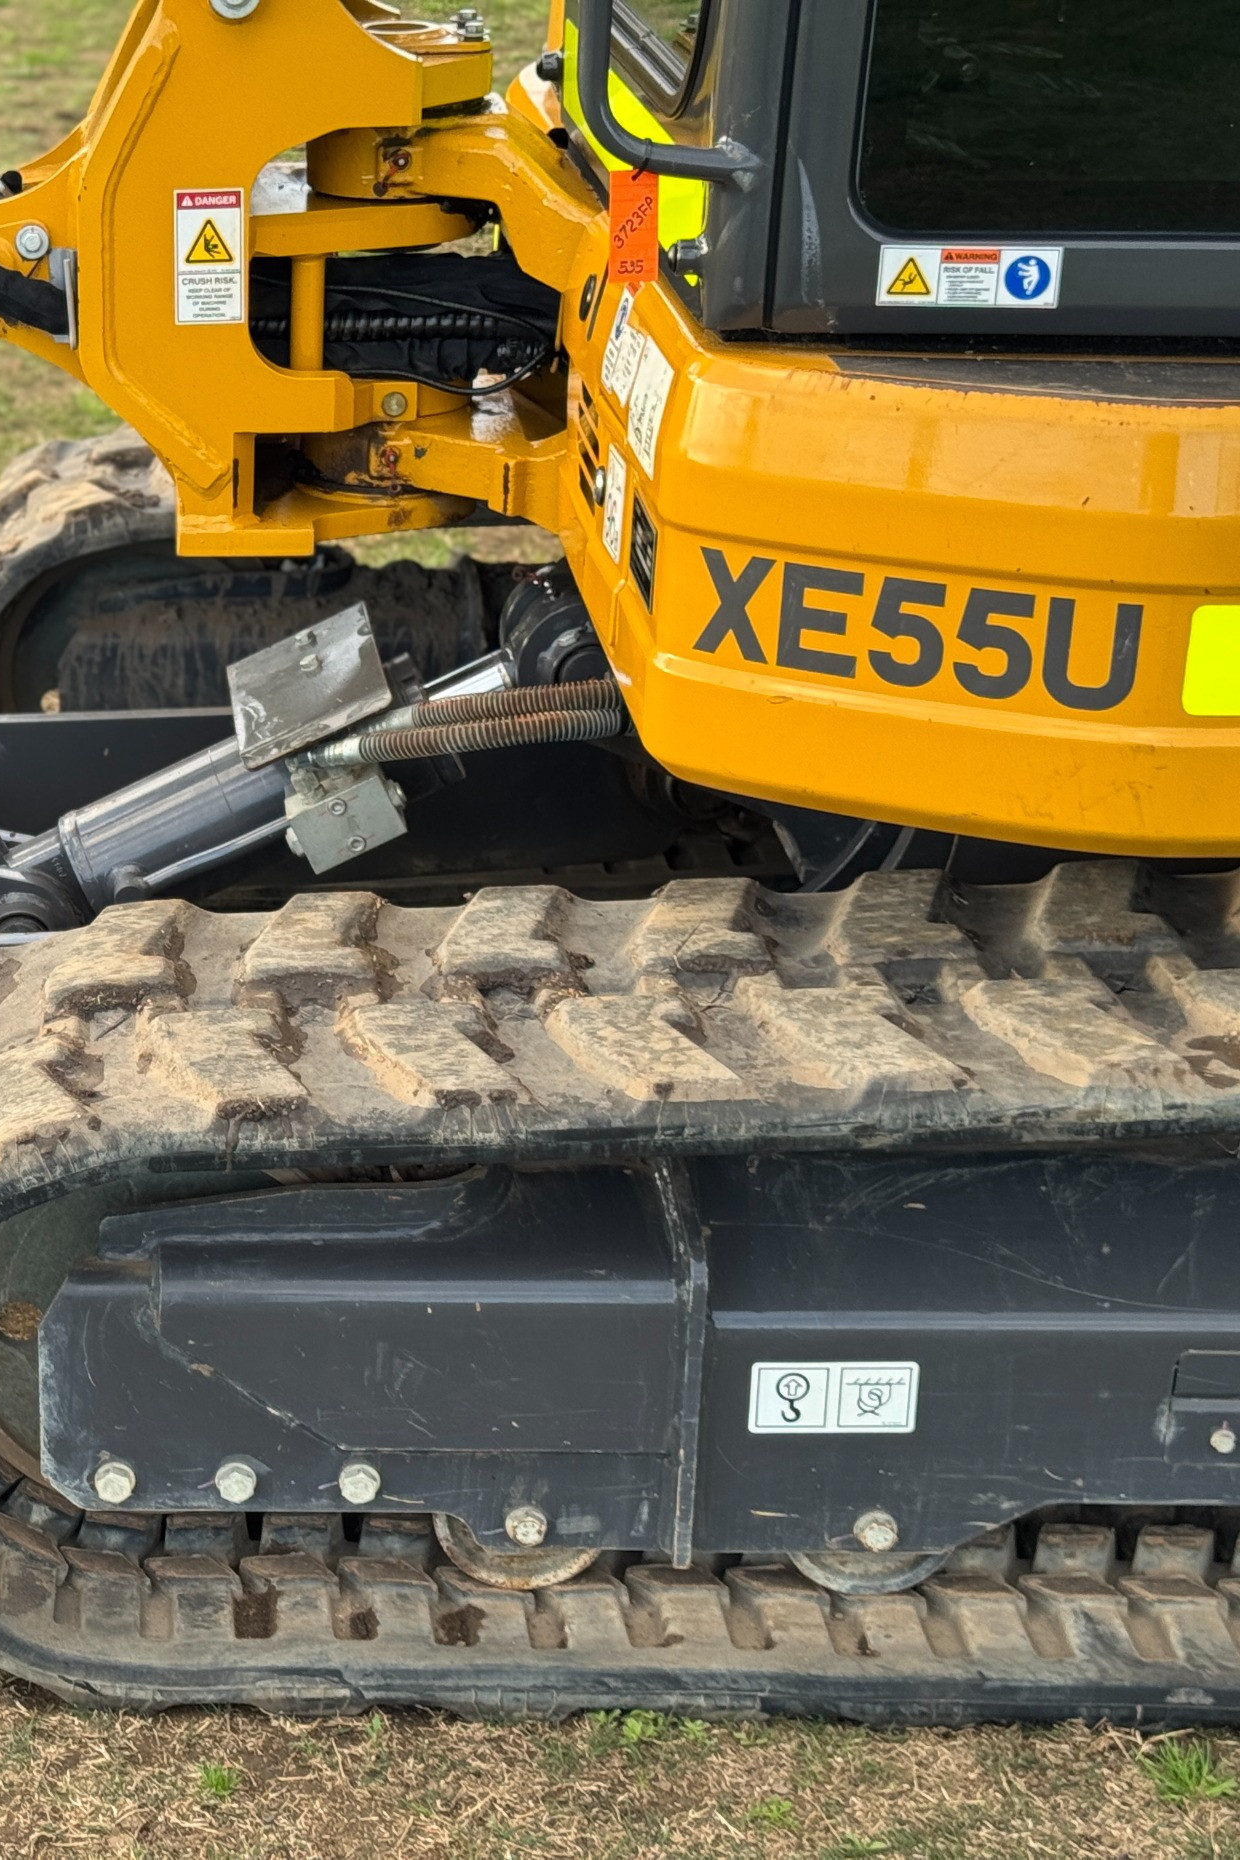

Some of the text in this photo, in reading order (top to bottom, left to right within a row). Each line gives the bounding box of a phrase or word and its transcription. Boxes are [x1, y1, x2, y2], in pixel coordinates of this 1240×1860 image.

[194, 195, 237, 206] DANGER
[613, 196, 653, 249] 3723FP
[955, 253, 998, 261] WARNING
[962, 266, 973, 274] OF
[181, 277, 212, 286] CRUSH
[692, 546, 1144, 711] XE55U
